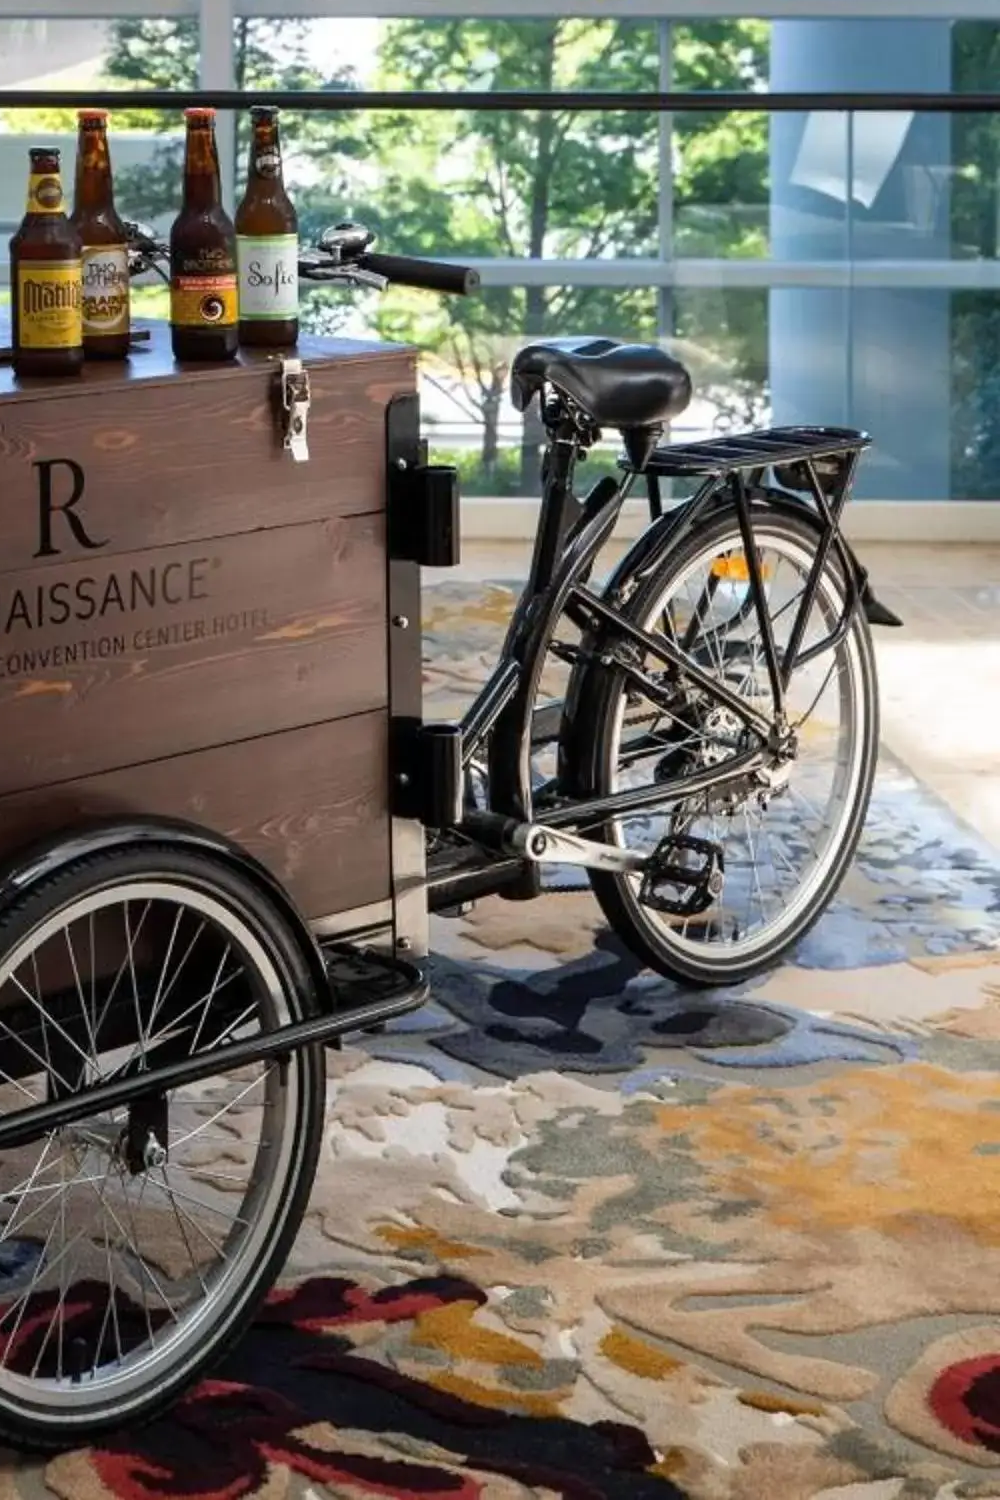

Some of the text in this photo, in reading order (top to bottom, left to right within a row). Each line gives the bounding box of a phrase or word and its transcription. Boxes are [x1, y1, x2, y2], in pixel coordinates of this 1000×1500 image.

[86, 263, 117, 278] TWO
[32, 457, 112, 559] R
[132, 618, 208, 651] CENTER
[212, 609, 271, 636] HOTEL
